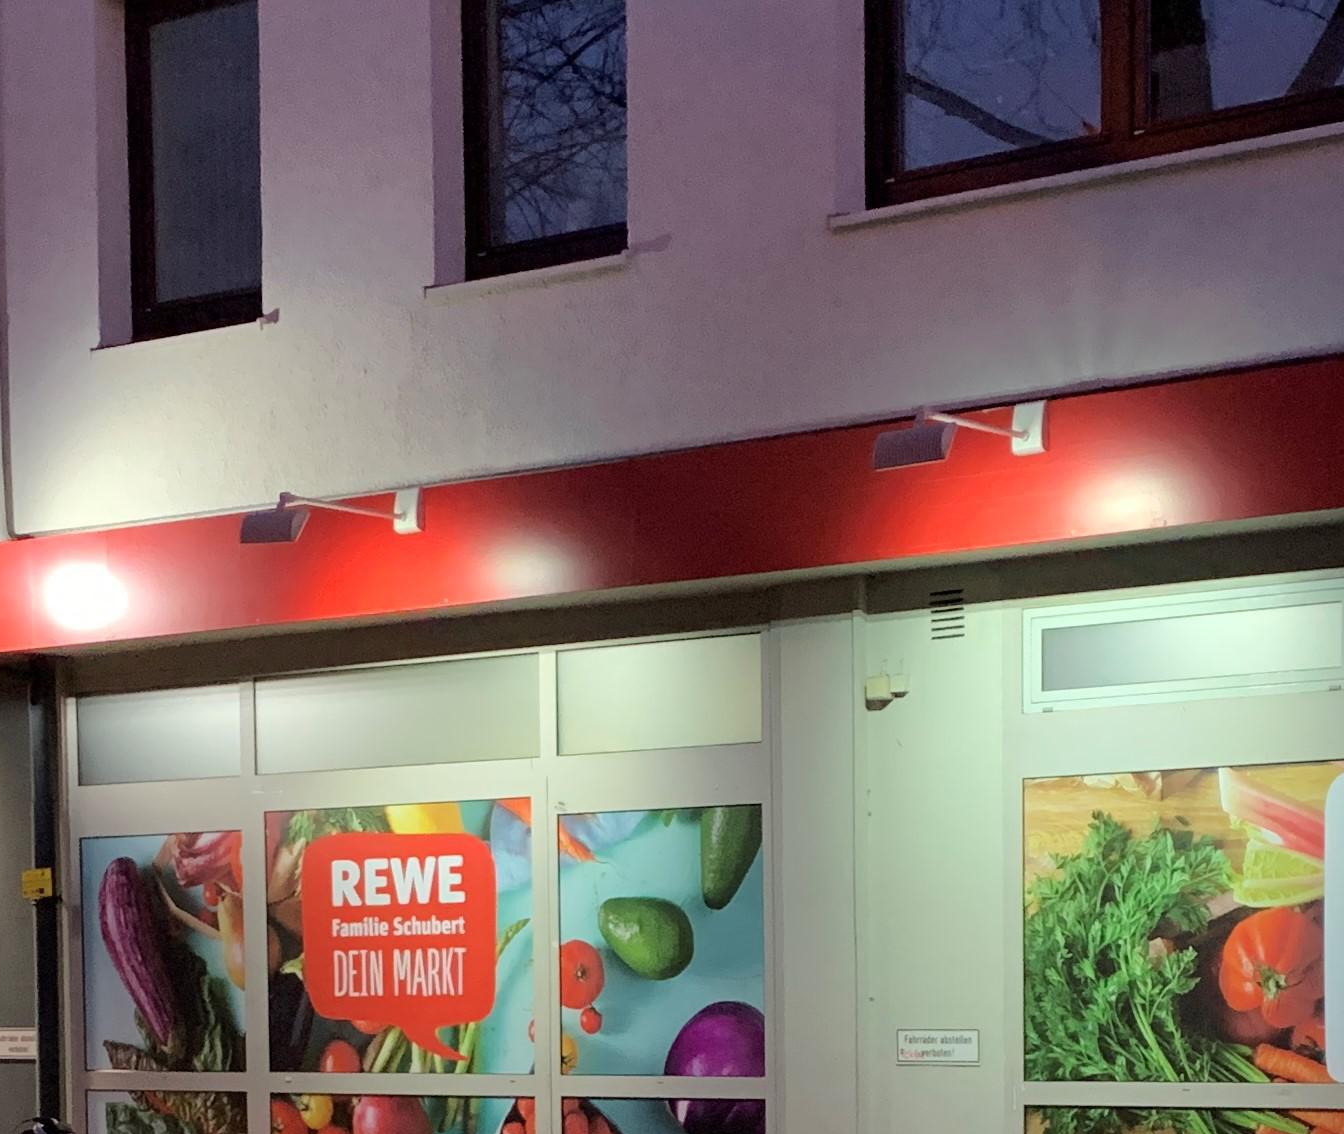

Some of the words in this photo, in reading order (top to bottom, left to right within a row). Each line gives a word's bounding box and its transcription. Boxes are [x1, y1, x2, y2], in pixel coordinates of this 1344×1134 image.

[331, 855, 466, 907] REWE
[332, 916, 388, 936] Familie
[393, 914, 465, 936] Schubert
[333, 950, 384, 997] DEIN
[393, 947, 467, 996] MARKT
